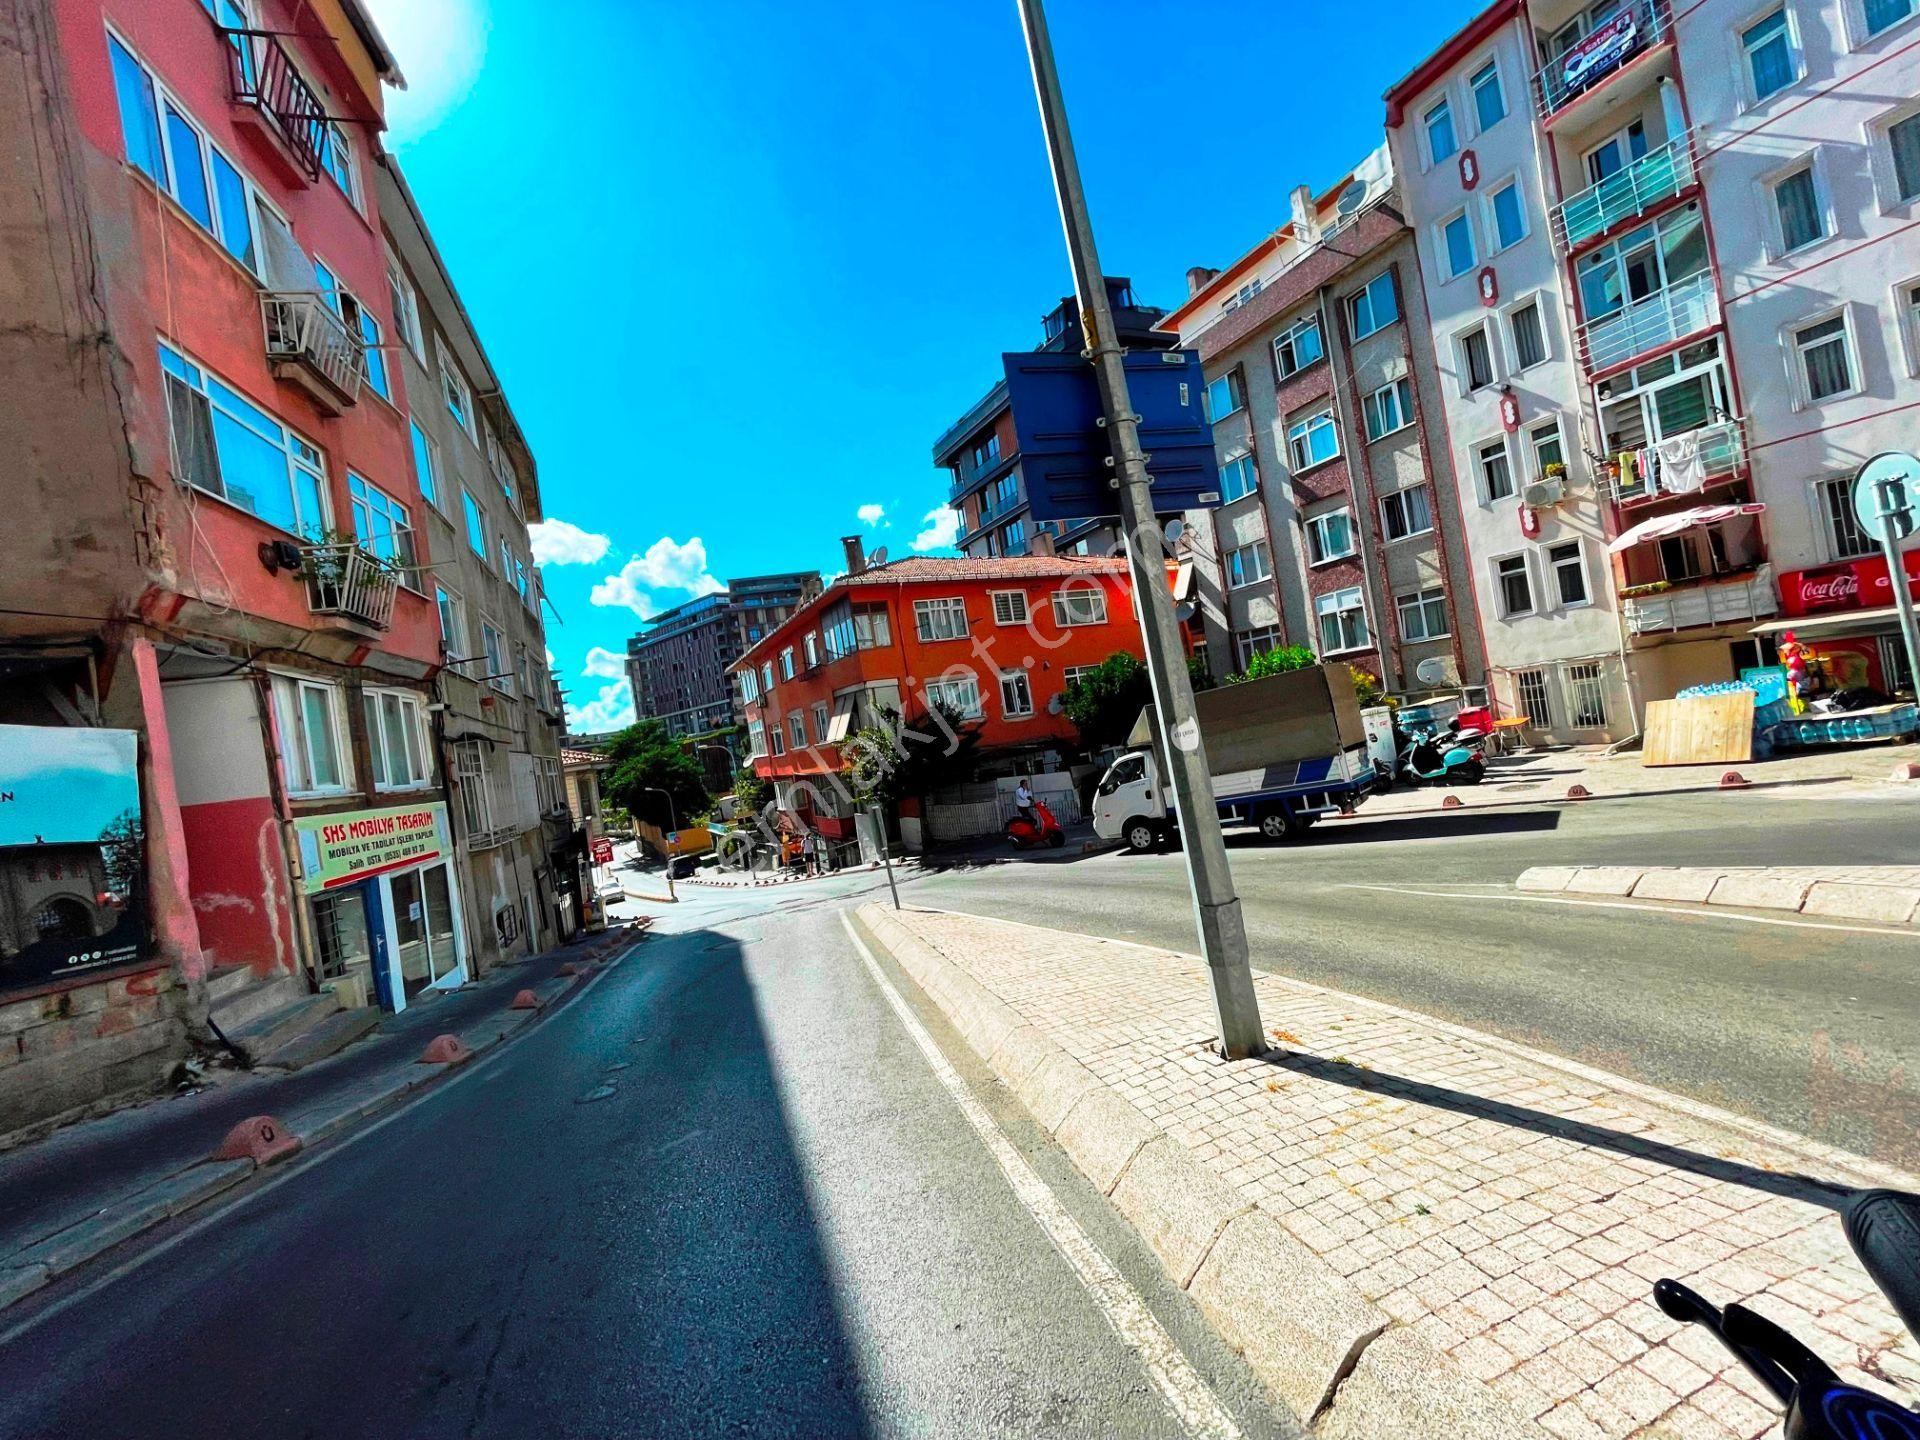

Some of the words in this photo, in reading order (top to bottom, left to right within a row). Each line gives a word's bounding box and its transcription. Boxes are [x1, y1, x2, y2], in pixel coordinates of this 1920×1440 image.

[322, 824, 347, 844] SHS
[348, 815, 394, 839] MOBİLYA
[396, 811, 434, 832] TASARIM
[328, 843, 360, 860] MOBİLYA
[362, 841, 371, 852] VE
[348, 858, 365, 870] Salih
